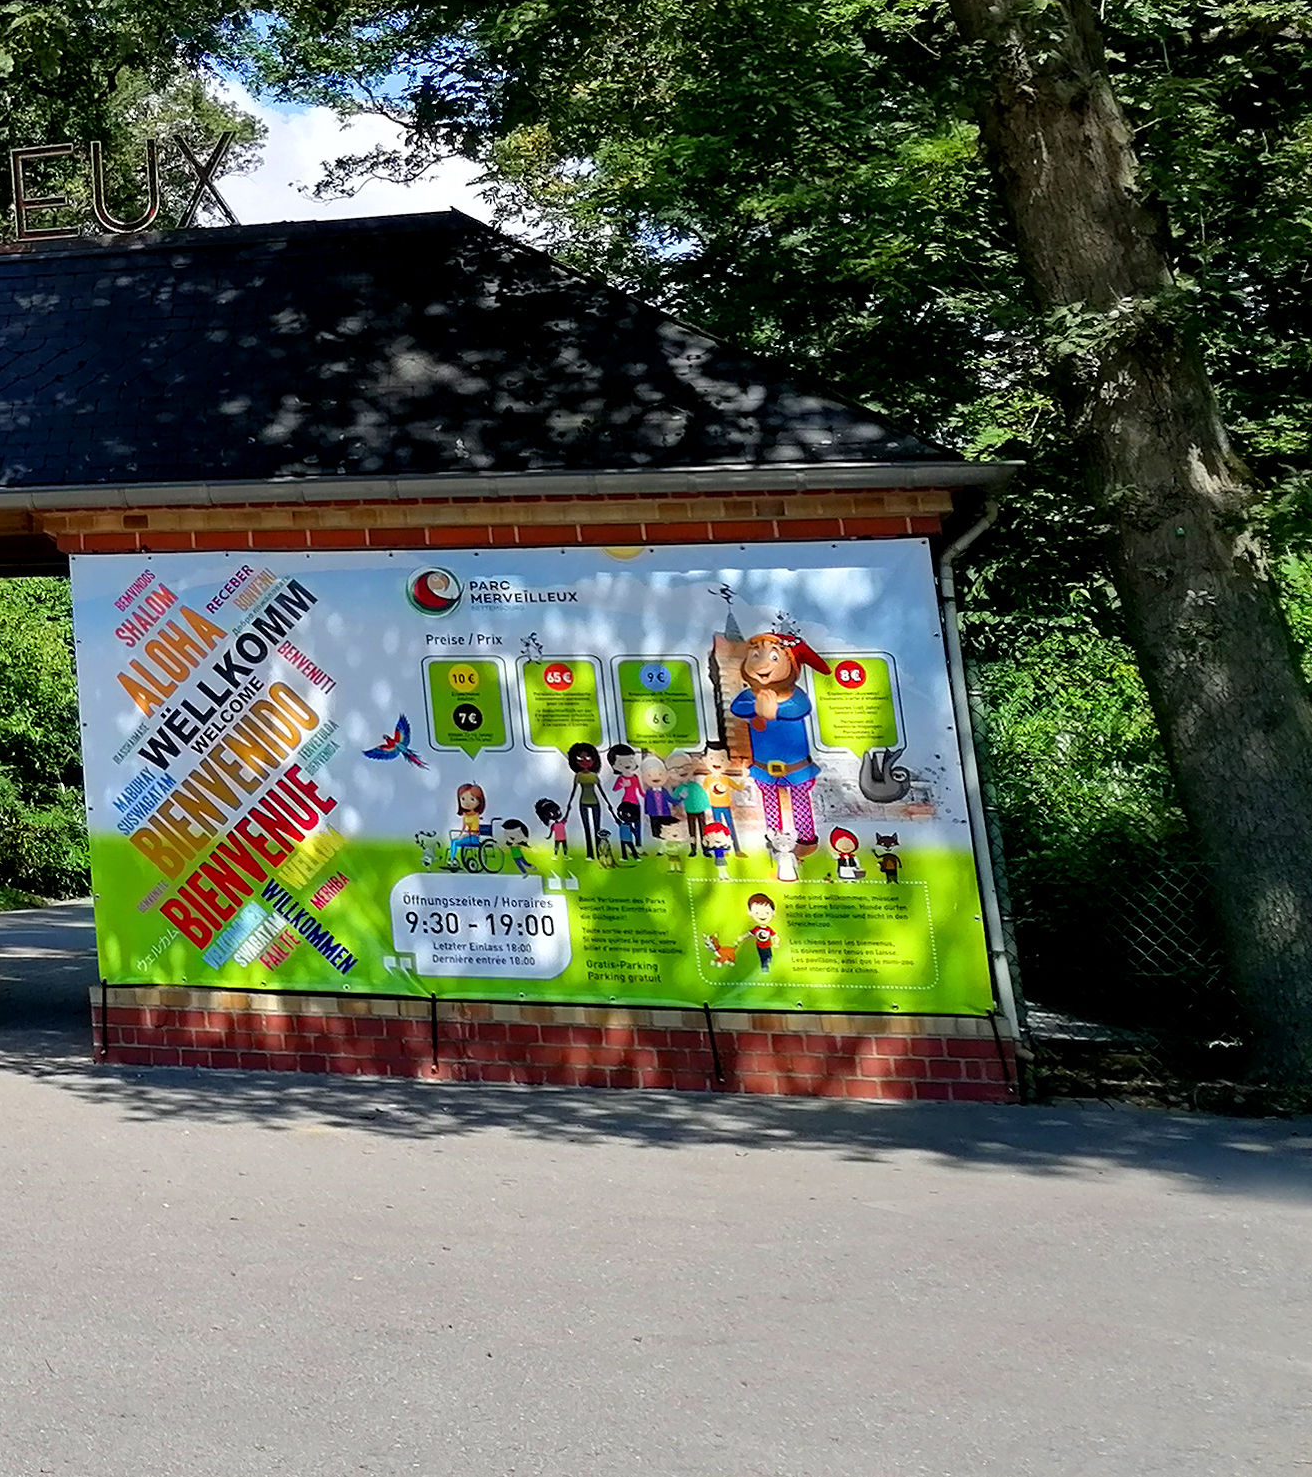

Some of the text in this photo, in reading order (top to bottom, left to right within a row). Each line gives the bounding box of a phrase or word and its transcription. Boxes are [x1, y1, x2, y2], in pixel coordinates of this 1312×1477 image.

[114, 569, 156, 612] BEMVINDOS
[206, 564, 253, 614] RECEBER
[469, 581, 510, 590] PARC
[115, 583, 178, 647] SHALOM
[426, 633, 503, 645] Preise / Prix
[116, 605, 227, 719] ALOHA
[138, 579, 318, 771] WËLLKOMM
[277, 640, 337, 695] BENVENUTI
[190, 675, 265, 755] WELCOME
[112, 766, 157, 814] MABUHAY
[117, 773, 176, 836] SUSWAGATAM
[130, 682, 319, 881] BIENVENIDO
[160, 763, 337, 950] BIENVENUE
[310, 871, 350, 911] MERHBA
[403, 892, 553, 909] Öffnungszeiten / Horaires
[233, 911, 289, 967] SWAGATAM
[261, 878, 358, 975] WILLKOMMEN
[405, 911, 459, 935] 9:30
[485, 913, 555, 937] 19:00
[433, 942, 532, 953] Letzter Einlass 18:00
[137, 929, 179, 972] ウェルカム
[432, 954, 535, 966] Dernière entrée 18:00
[586, 960, 658, 972] Gratis-Parking
[588, 971, 662, 983] Parking gratuit
